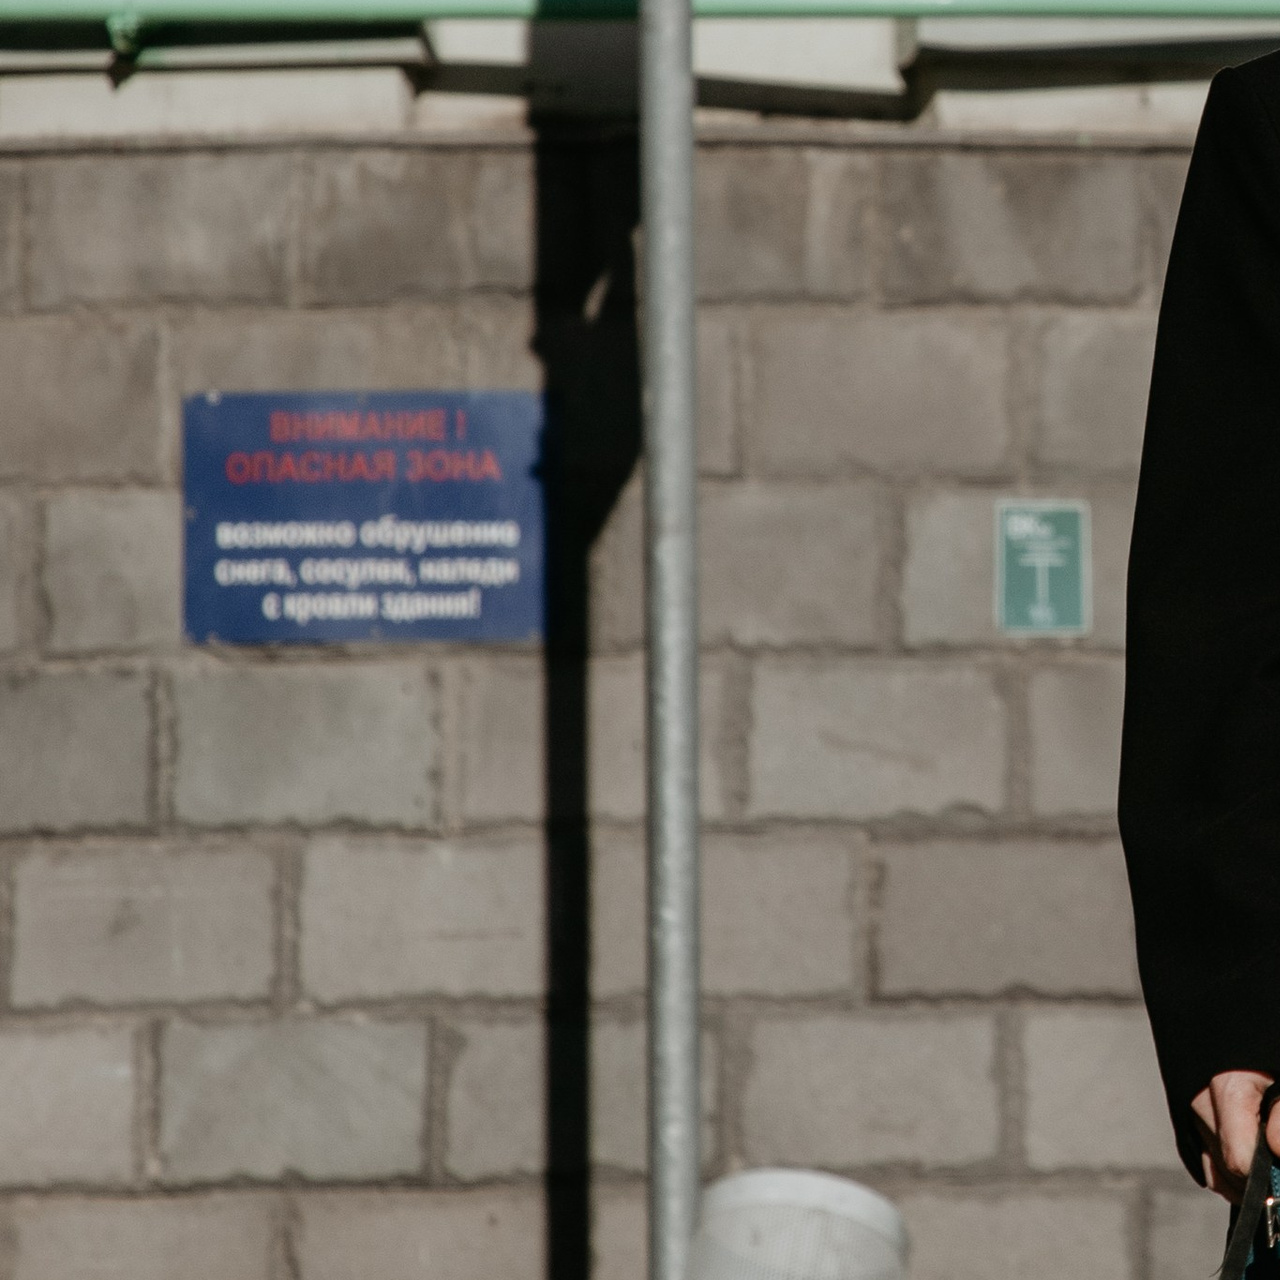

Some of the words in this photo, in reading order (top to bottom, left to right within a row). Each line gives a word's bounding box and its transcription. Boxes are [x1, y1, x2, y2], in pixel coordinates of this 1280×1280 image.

[270, 409, 446, 442] ВНИМАНИЕ
[225, 451, 395, 484] ОПАСНАЯ
[406, 450, 502, 482] ЗОНА
[216, 521, 356, 549] возможно
[360, 514, 520, 554] обрушение
[262, 592, 281, 620] с
